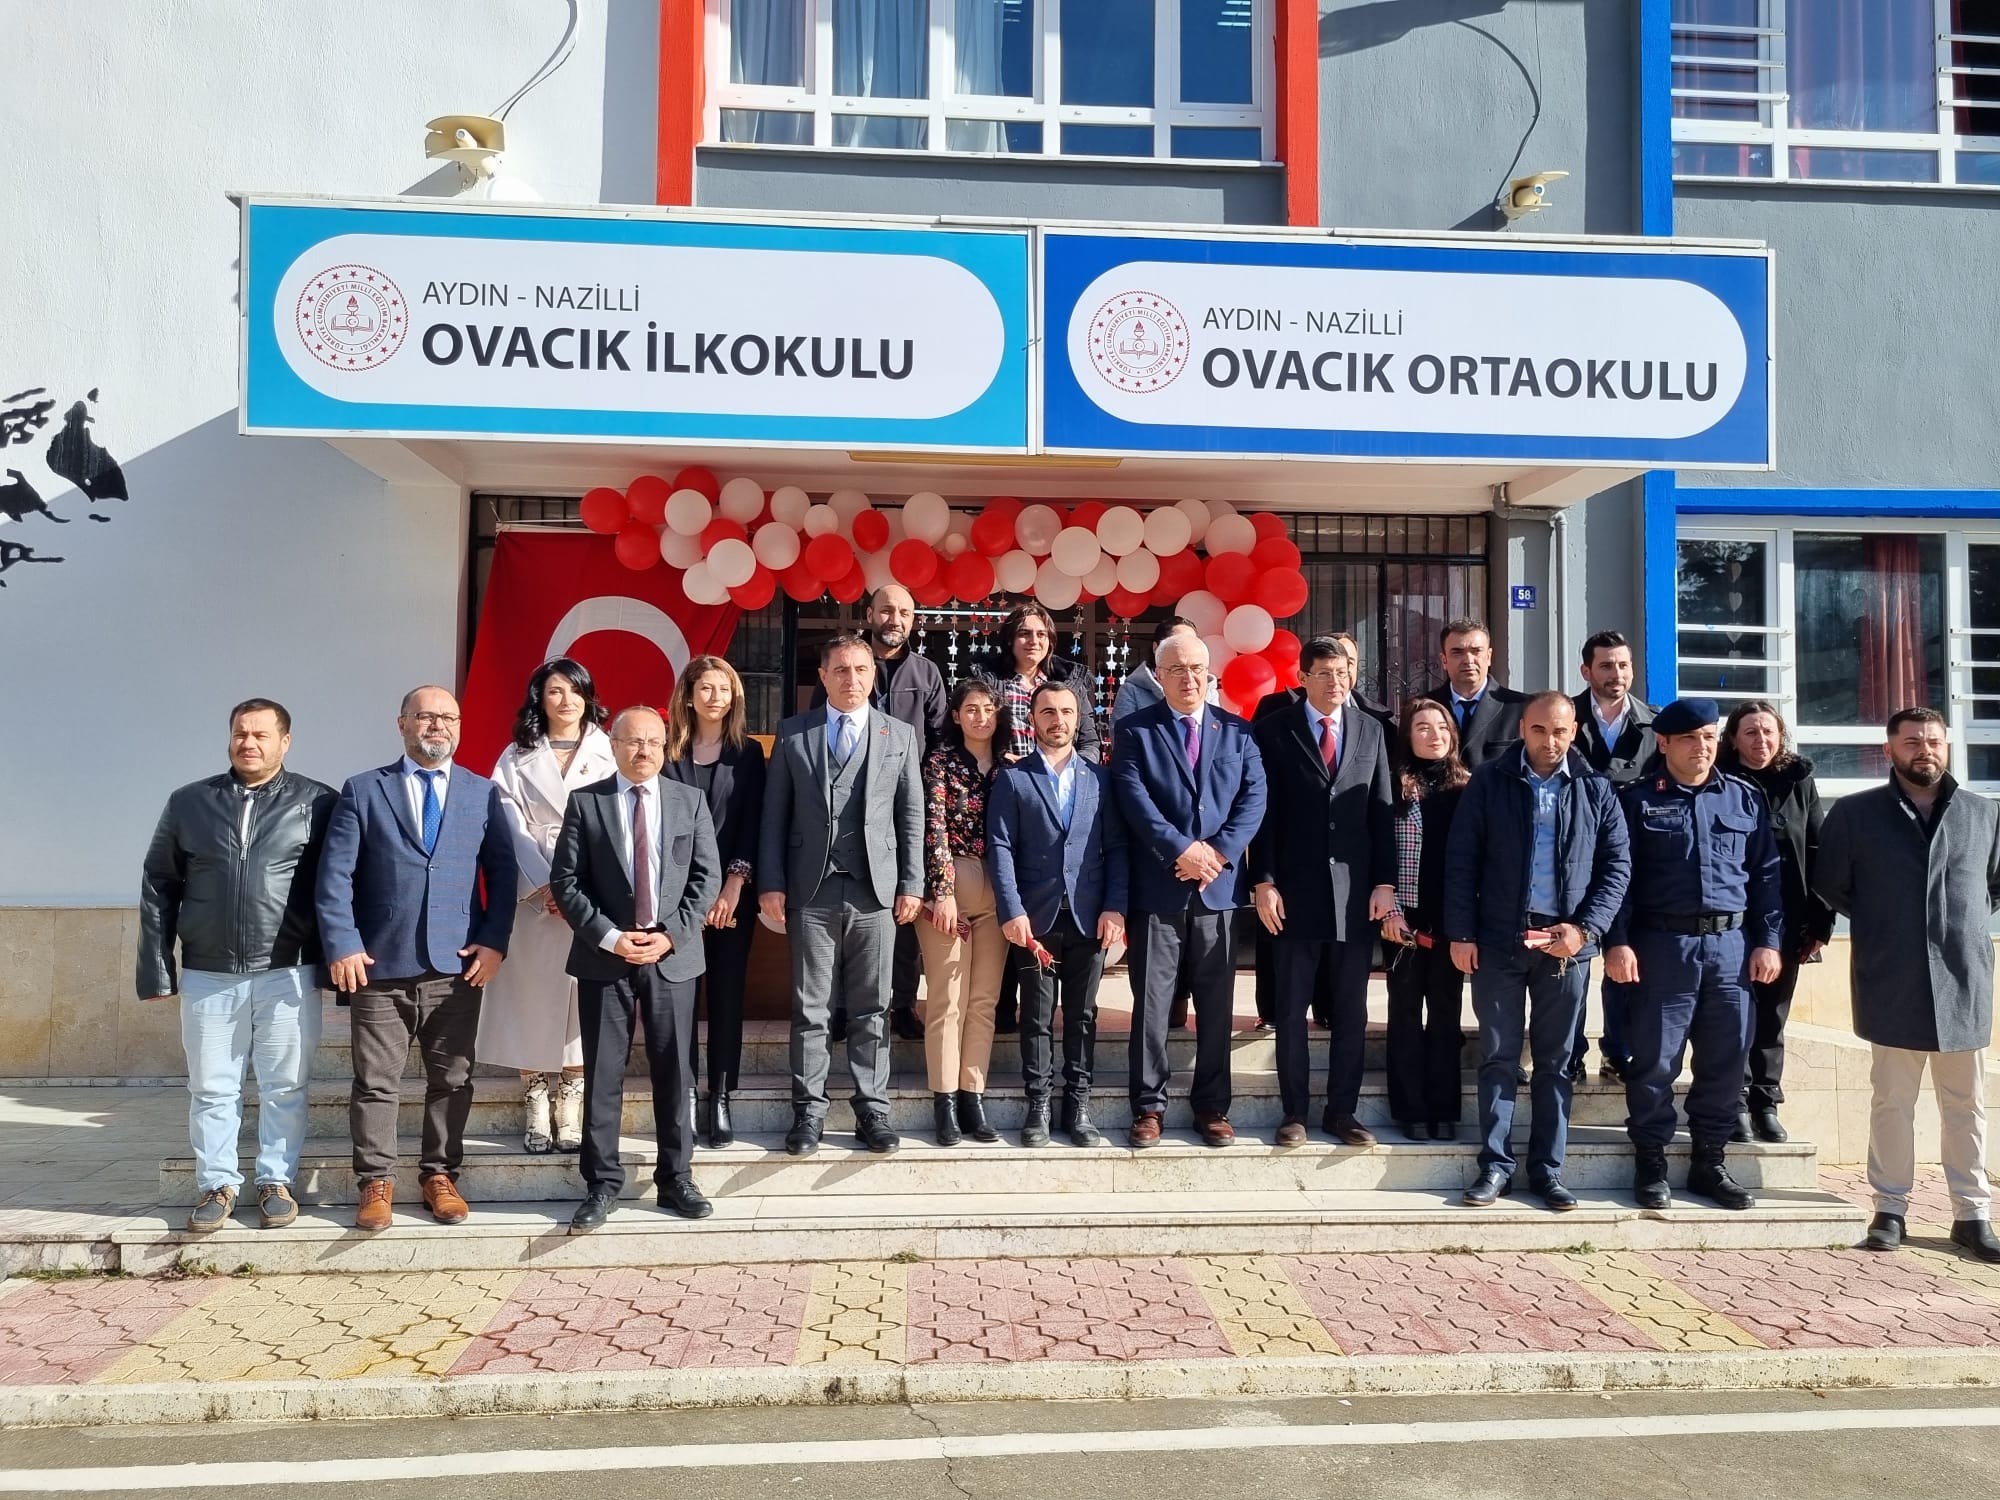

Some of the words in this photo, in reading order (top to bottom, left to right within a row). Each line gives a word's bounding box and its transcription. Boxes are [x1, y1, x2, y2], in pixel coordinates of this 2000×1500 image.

[317, 284, 349, 324] CUMHURİYETİ
[422, 281, 508, 307] AYDIN
[535, 283, 640, 312] NAZİLLİ
[360, 319, 388, 351] BAKANLIĞI
[1202, 307, 1281, 332] AYDIN
[1306, 309, 1403, 336] NAZİLLİ
[319, 326, 344, 351] TÜRKİYE
[422, 323, 631, 372] OVACIK
[646, 320, 914, 380] İLKOKULU
[1202, 347, 1395, 393] OVACIK
[1407, 354, 1718, 402] ORTAOKULU
[1518, 589, 1531, 600] 58
